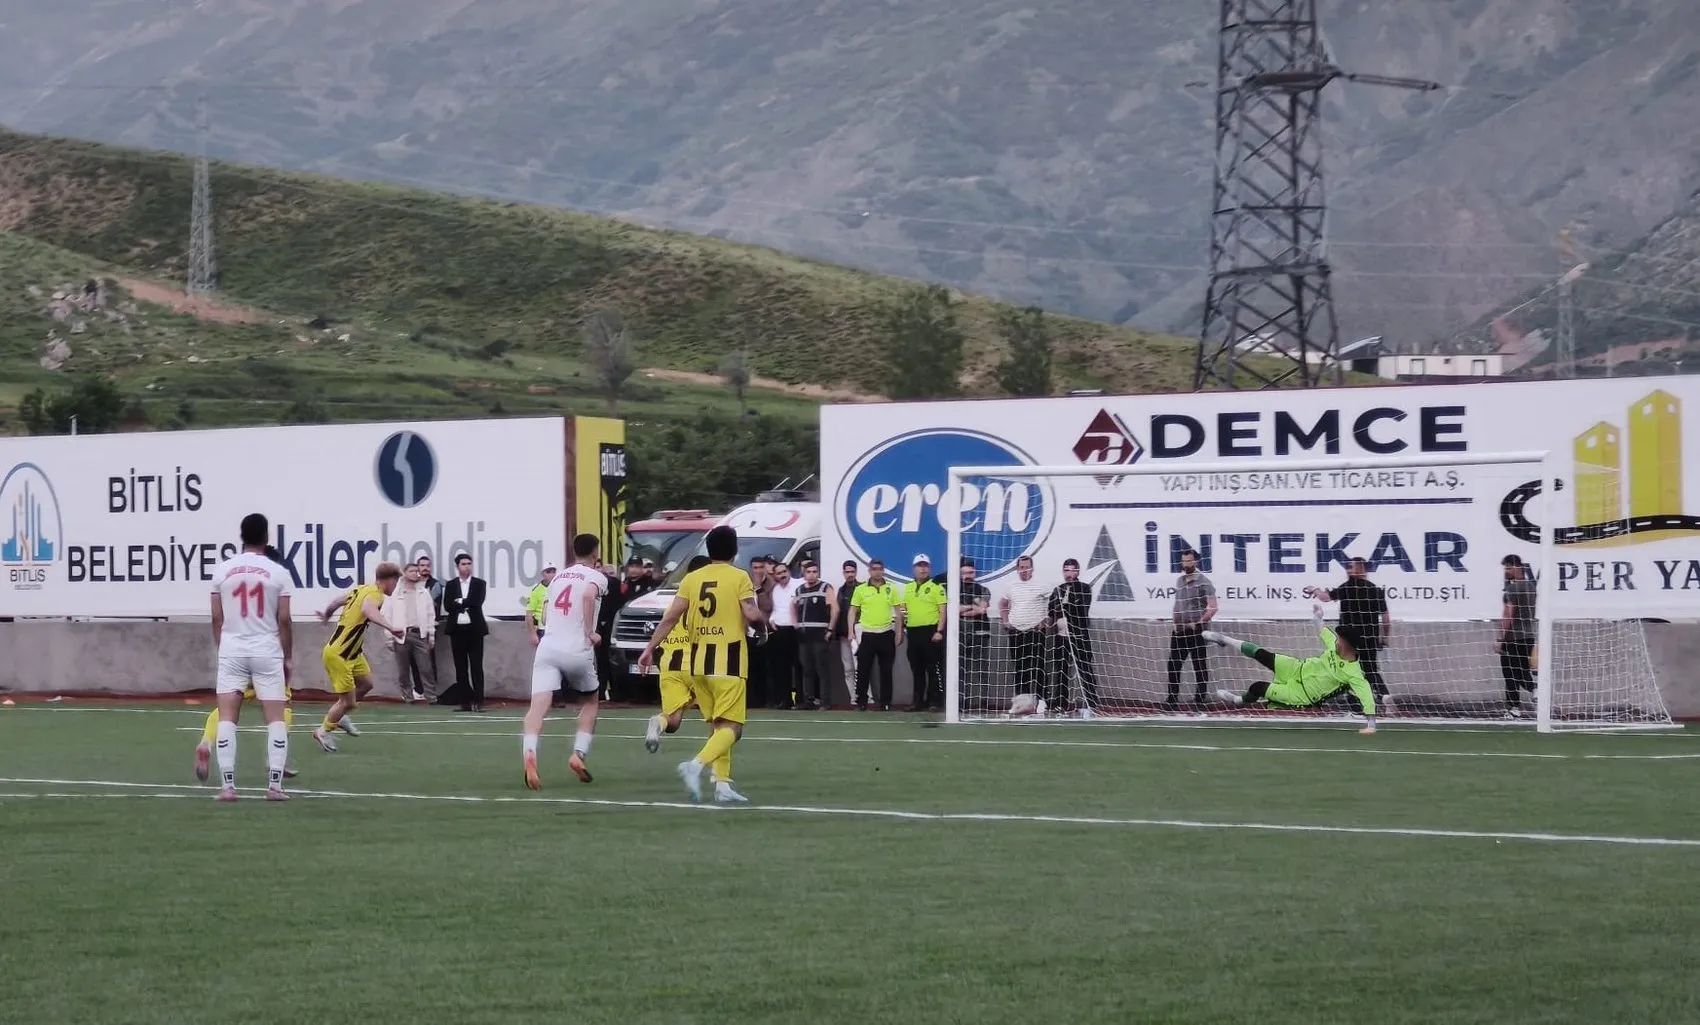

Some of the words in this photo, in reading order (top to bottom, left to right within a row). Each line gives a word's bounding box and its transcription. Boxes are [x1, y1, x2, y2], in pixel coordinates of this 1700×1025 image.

[1150, 405, 1468, 459] DEMCE
[109, 466, 203, 513] BİTLİS
[1160, 475, 1203, 491] YAPI
[1329, 469, 1419, 489] TİCARET
[1424, 470, 1465, 491] A.Ş.
[855, 481, 1033, 534] eren
[68, 536, 246, 582] BELEDİYE
[1144, 520, 1469, 574] İNTEKAR
[232, 581, 265, 618] 11
[554, 584, 573, 616] 4
[698, 580, 718, 618] 5
[1146, 586, 1176, 600] YAP
[1226, 586, 1262, 600] ELK.
[1383, 583, 1470, 602] İC.LTD.ŞTİ.
